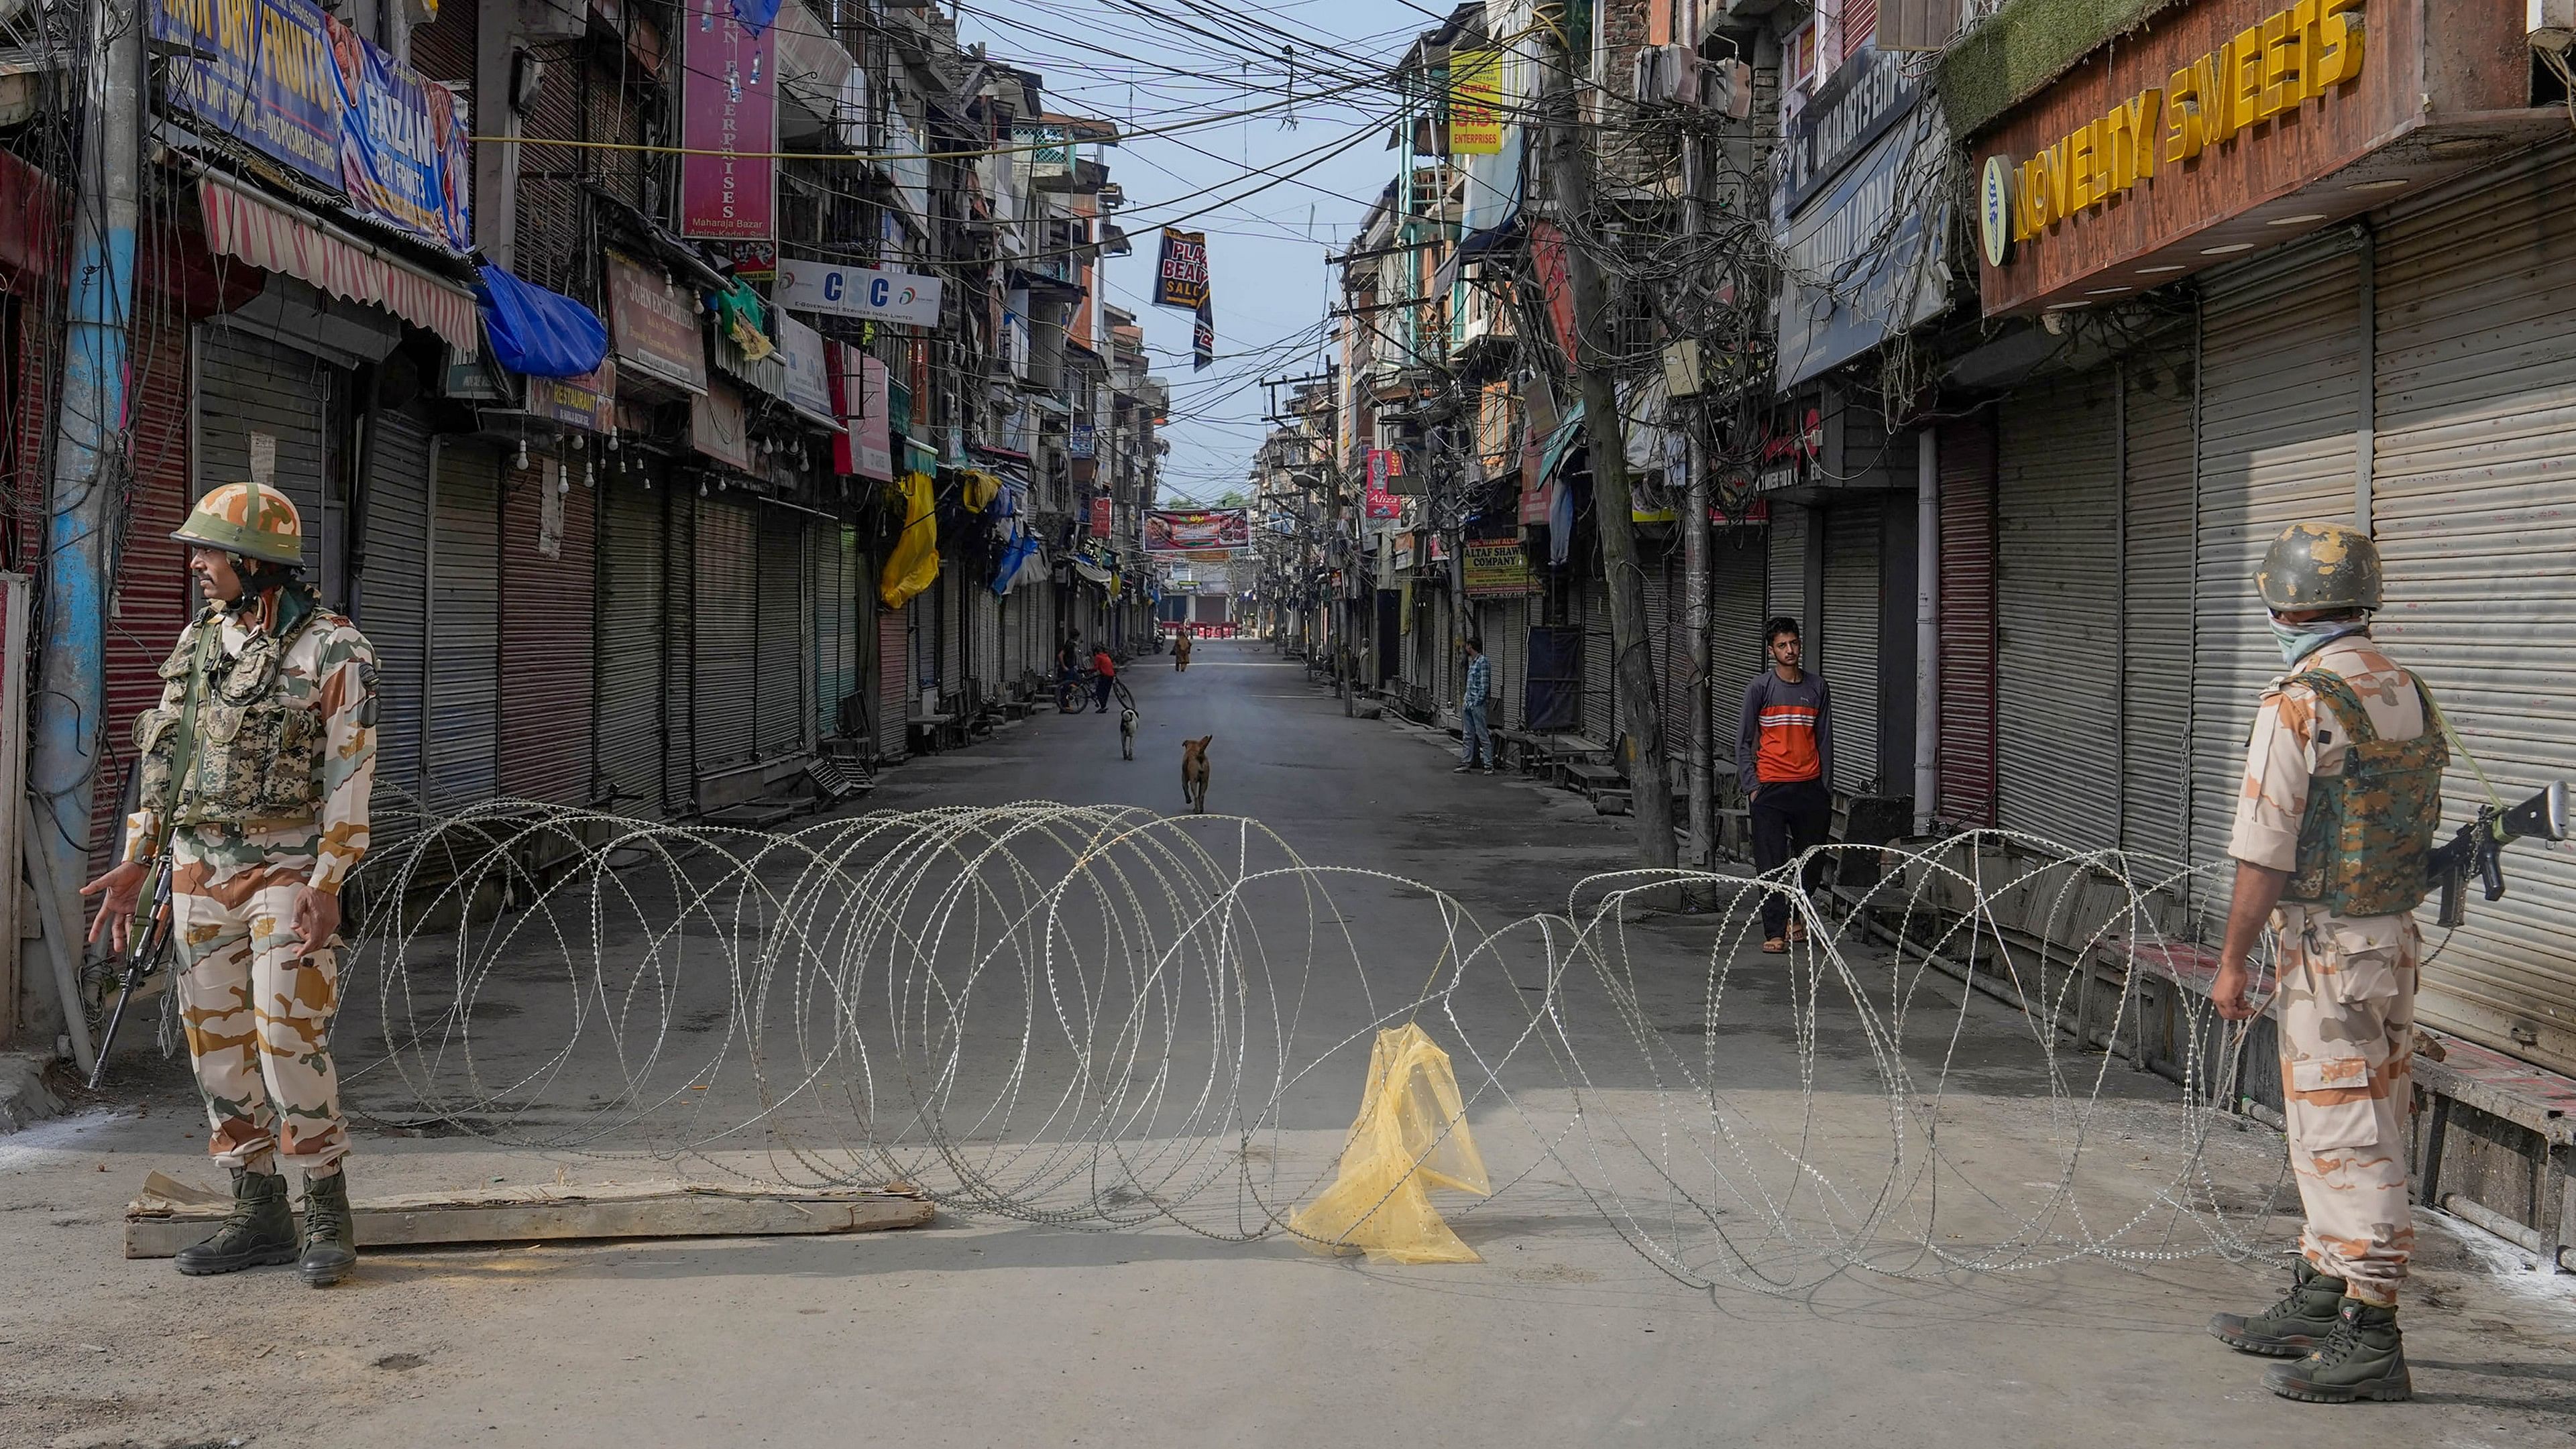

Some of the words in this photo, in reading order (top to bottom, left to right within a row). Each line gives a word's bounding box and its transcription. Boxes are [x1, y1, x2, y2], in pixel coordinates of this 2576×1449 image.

[260, 3, 331, 113] FRUITS
[206, 75, 223, 113] DRY
[227, 88, 257, 131] FRUITS
[268, 111, 314, 160] DISPOSABLE
[314, 139, 335, 172] ITEMS
[365, 80, 431, 168] FAIZAN
[1844, 70, 1872, 150] ARTS
[2013, 87, 2162, 243] NOVELTY
[2166, 0, 2365, 163] SWEETS
[1454, 133, 1497, 143] ENTERPRISES
[376, 149, 394, 184] DRY
[397, 168, 425, 201] FRUITS
[693, 218, 734, 228] Maharaja
[737, 219, 763, 229] Bazar
[629, 281, 652, 312] JOHN
[824, 272, 889, 307] CSC
[890, 312, 913, 321] LIMITED
[553, 383, 598, 414] RESTAURANT
[1368, 494, 1398, 504] Aliza
[1464, 548, 1492, 559] ALTAF
[1473, 556, 1516, 567] COMPANY
